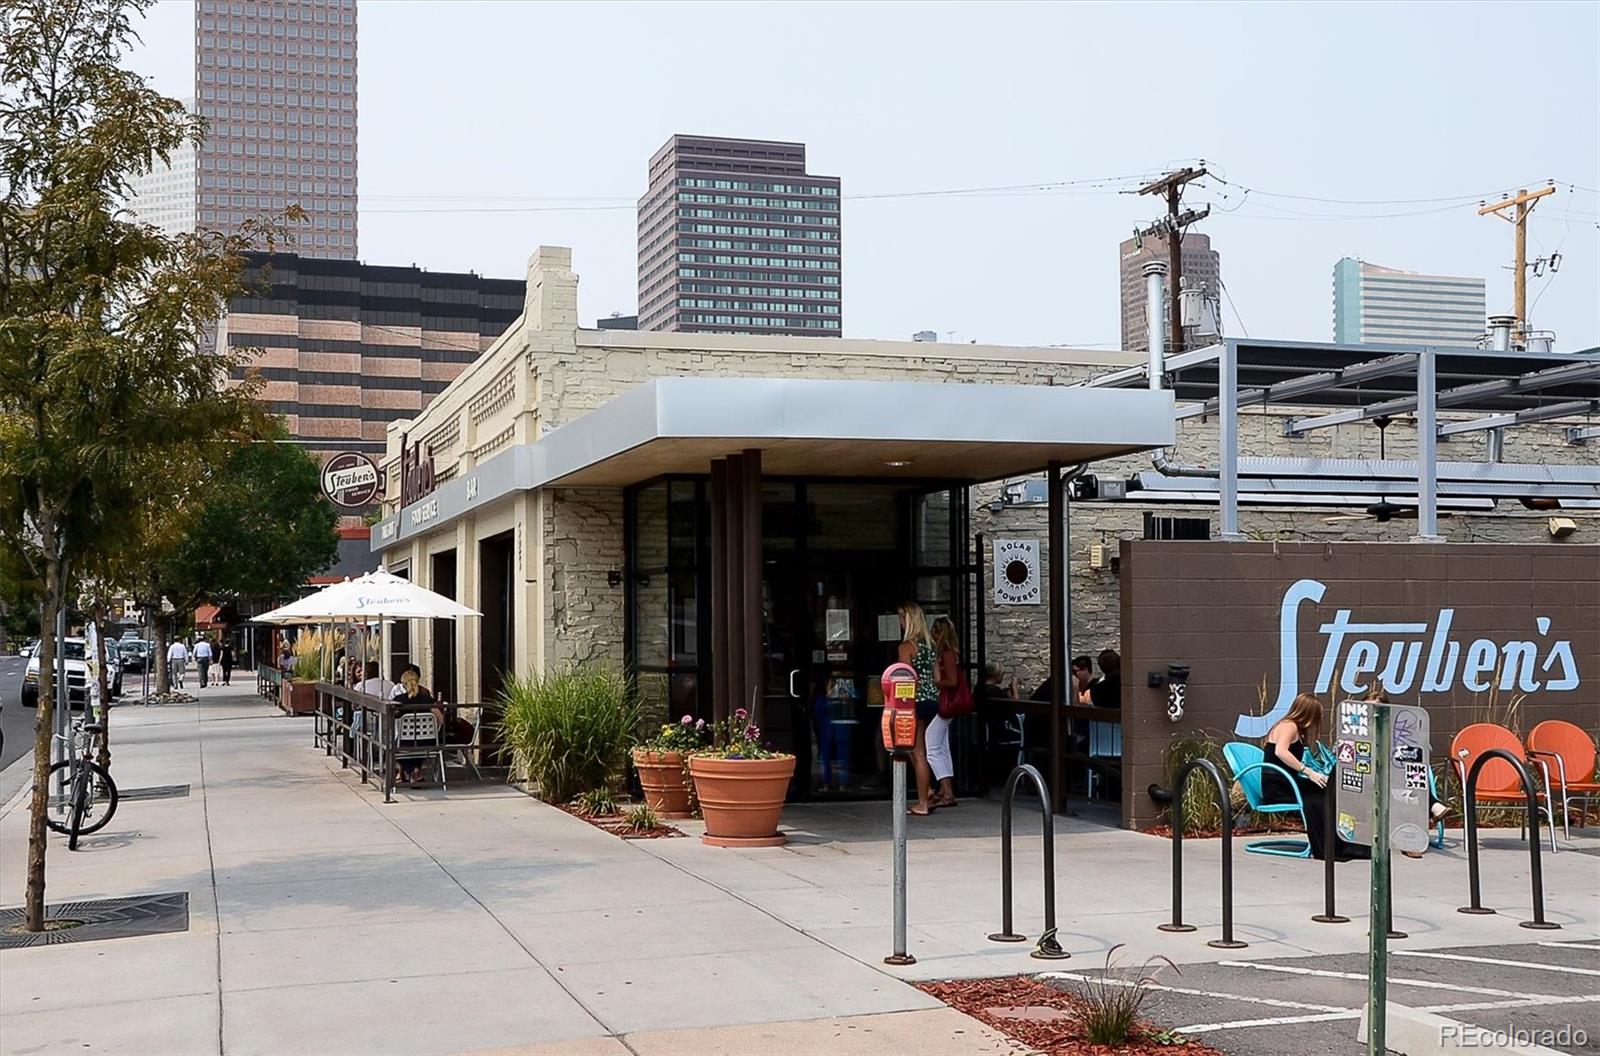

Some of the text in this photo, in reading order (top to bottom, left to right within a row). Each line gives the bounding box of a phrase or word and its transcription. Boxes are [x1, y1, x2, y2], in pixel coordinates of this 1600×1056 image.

[328, 471, 375, 494] Steuben's
[1001, 542, 1032, 553] SOLAR
[997, 587, 1038, 602] POWERED
[1234, 579, 1580, 738] Steuben's
[1341, 703, 1368, 716] INK
[1341, 724, 1368, 736] STR
[1407, 764, 1426, 774] INK
